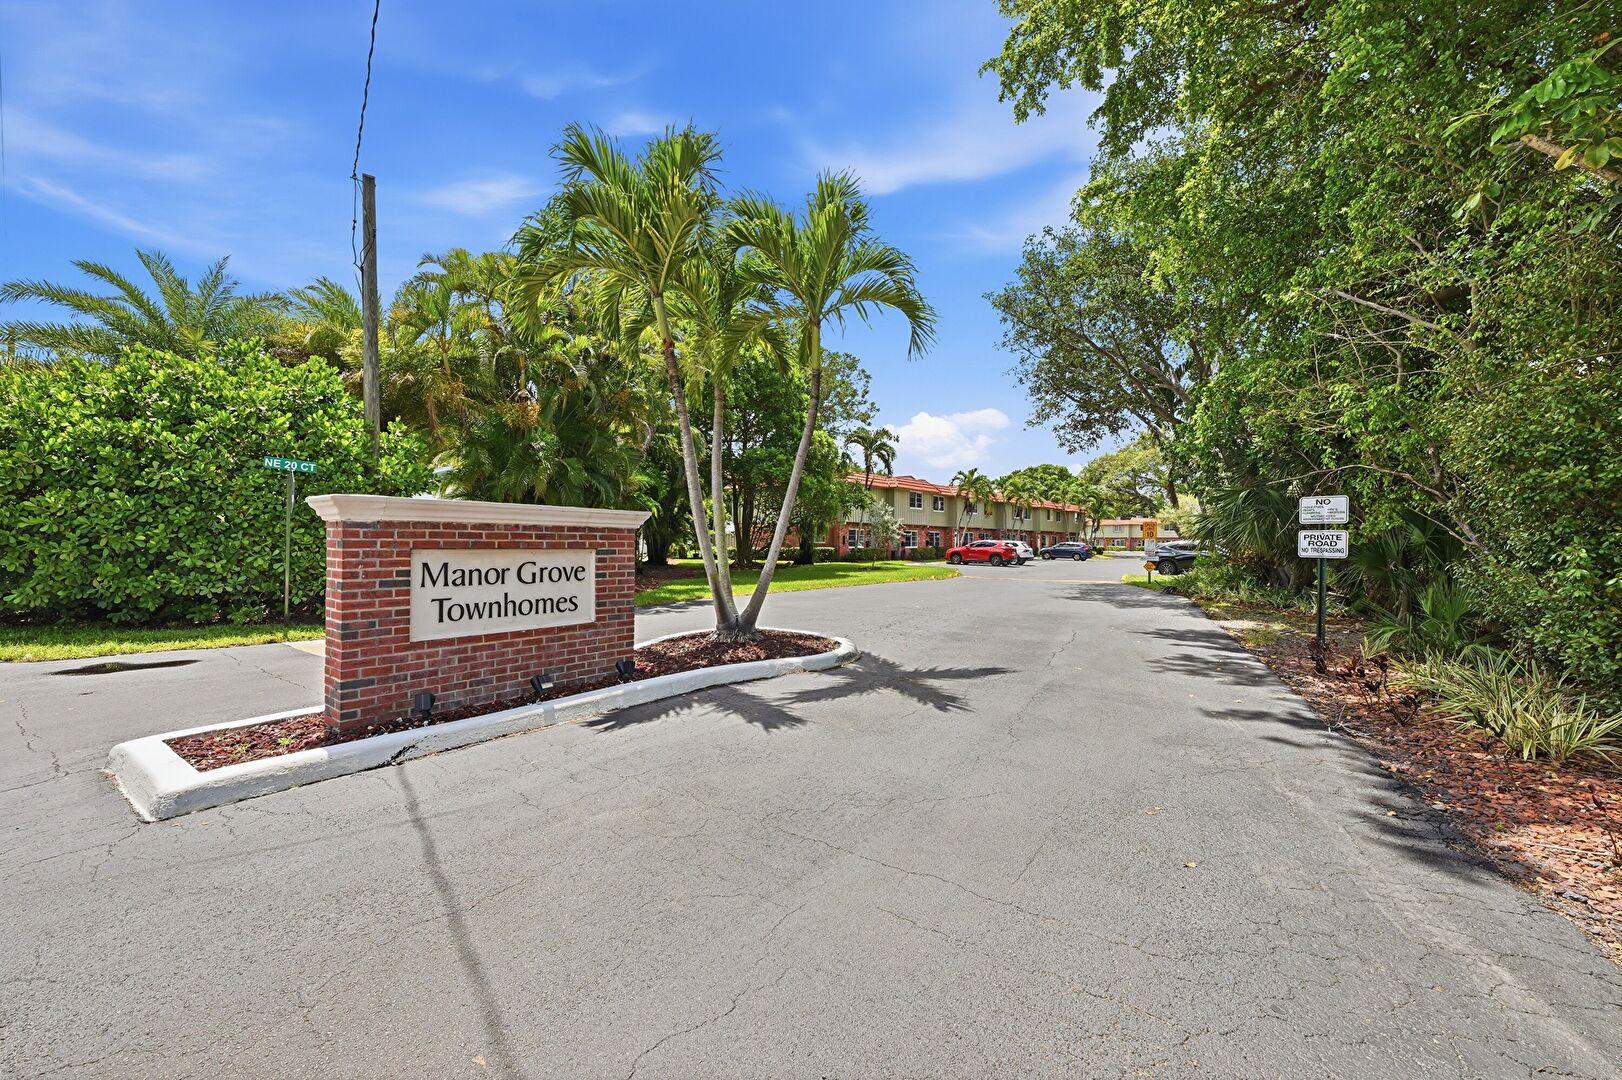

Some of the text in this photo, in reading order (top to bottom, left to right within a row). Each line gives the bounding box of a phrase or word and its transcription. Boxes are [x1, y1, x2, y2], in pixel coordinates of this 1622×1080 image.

[264, 458, 316, 472] NE 20 CT
[420, 561, 586, 588] Manor Grove
[431, 592, 579, 623] Townhomes
